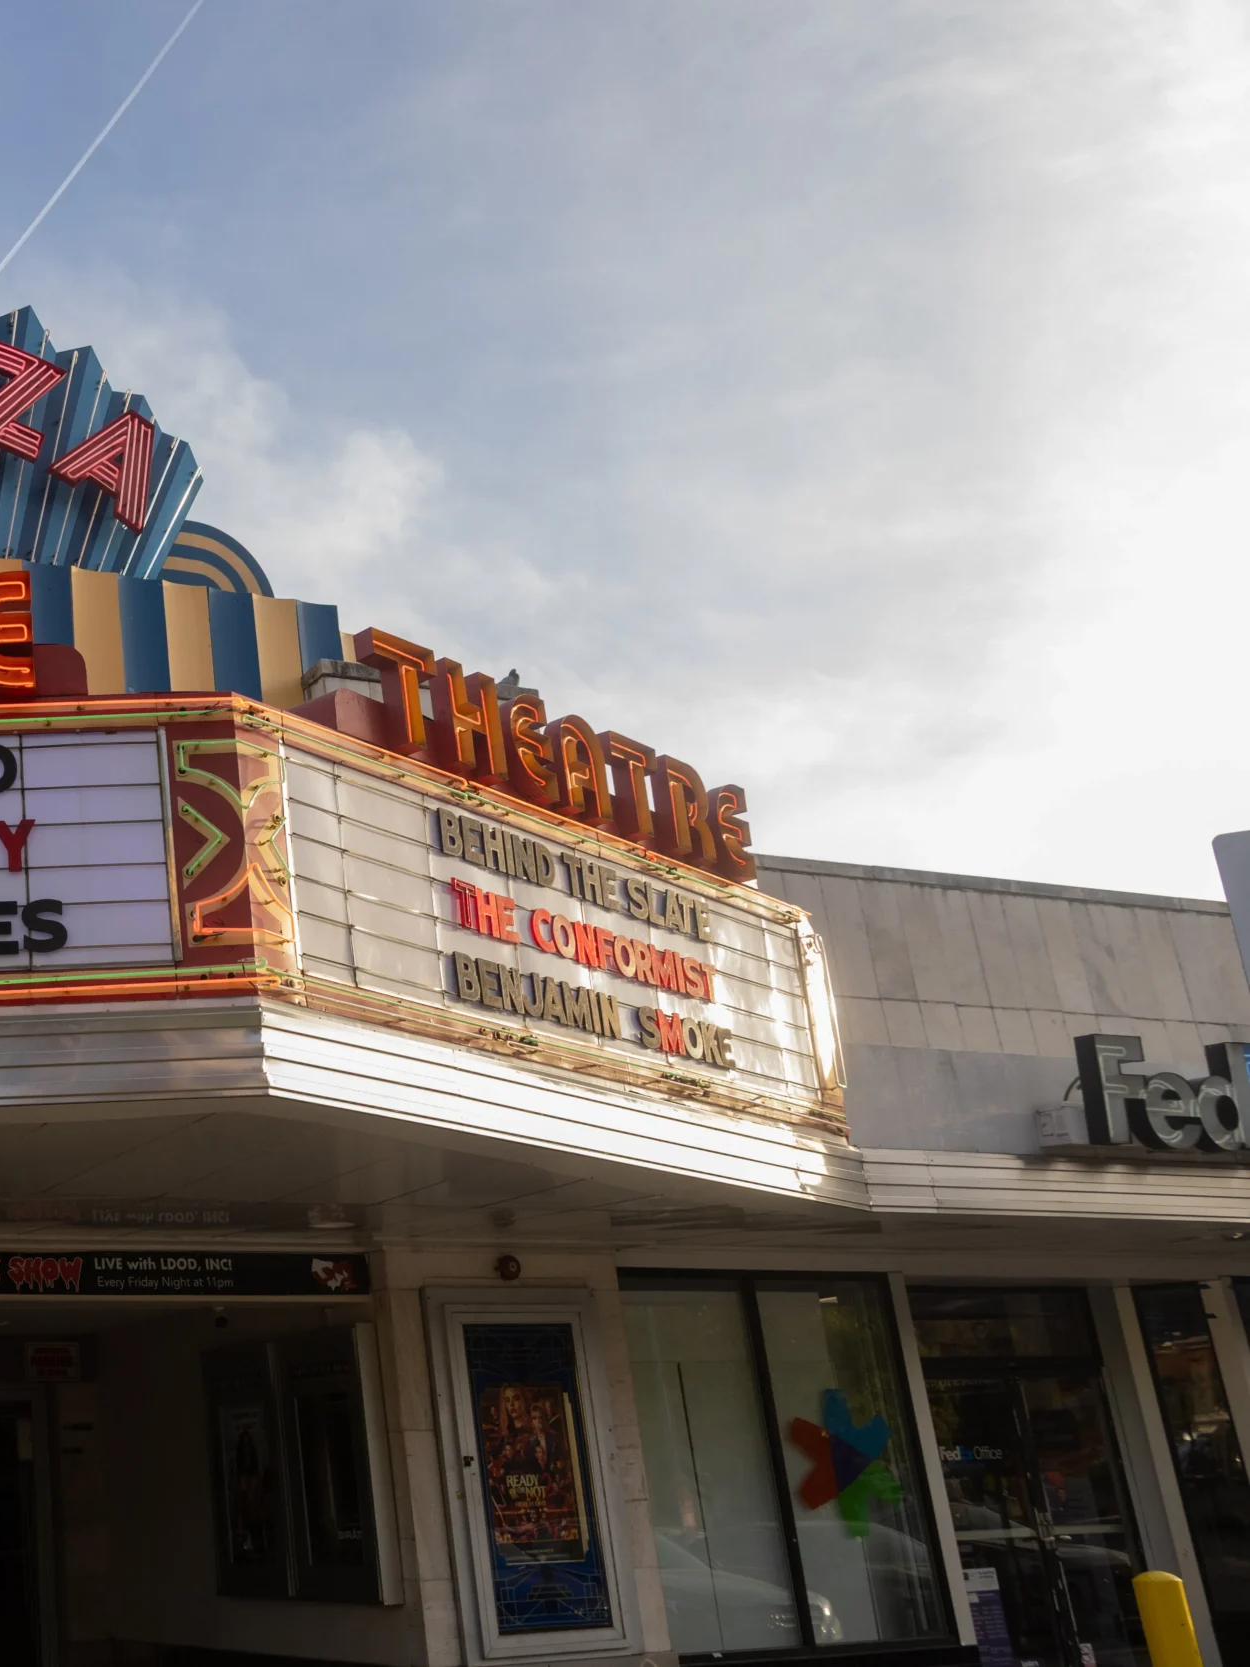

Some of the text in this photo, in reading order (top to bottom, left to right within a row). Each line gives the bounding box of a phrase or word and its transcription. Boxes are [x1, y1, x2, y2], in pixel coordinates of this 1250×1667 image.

[354, 626, 752, 882] THEATRE
[438, 807, 714, 943] BEHIND THE SLATE
[450, 876, 717, 1004] THE CONFORMIST
[452, 951, 736, 1070] BENJAMIN SMOKE
[1074, 1033, 1250, 1152] Fed
[7, 1255, 84, 1292] SHOW
[94, 1257, 232, 1272] LIVE with LDOD, INC!
[97, 1276, 234, 1290] Every Friday Night at 11pm
[973, 1445, 1003, 1460] Office
[506, 1474, 539, 1488] READY
[525, 1485, 547, 1499] NOT
